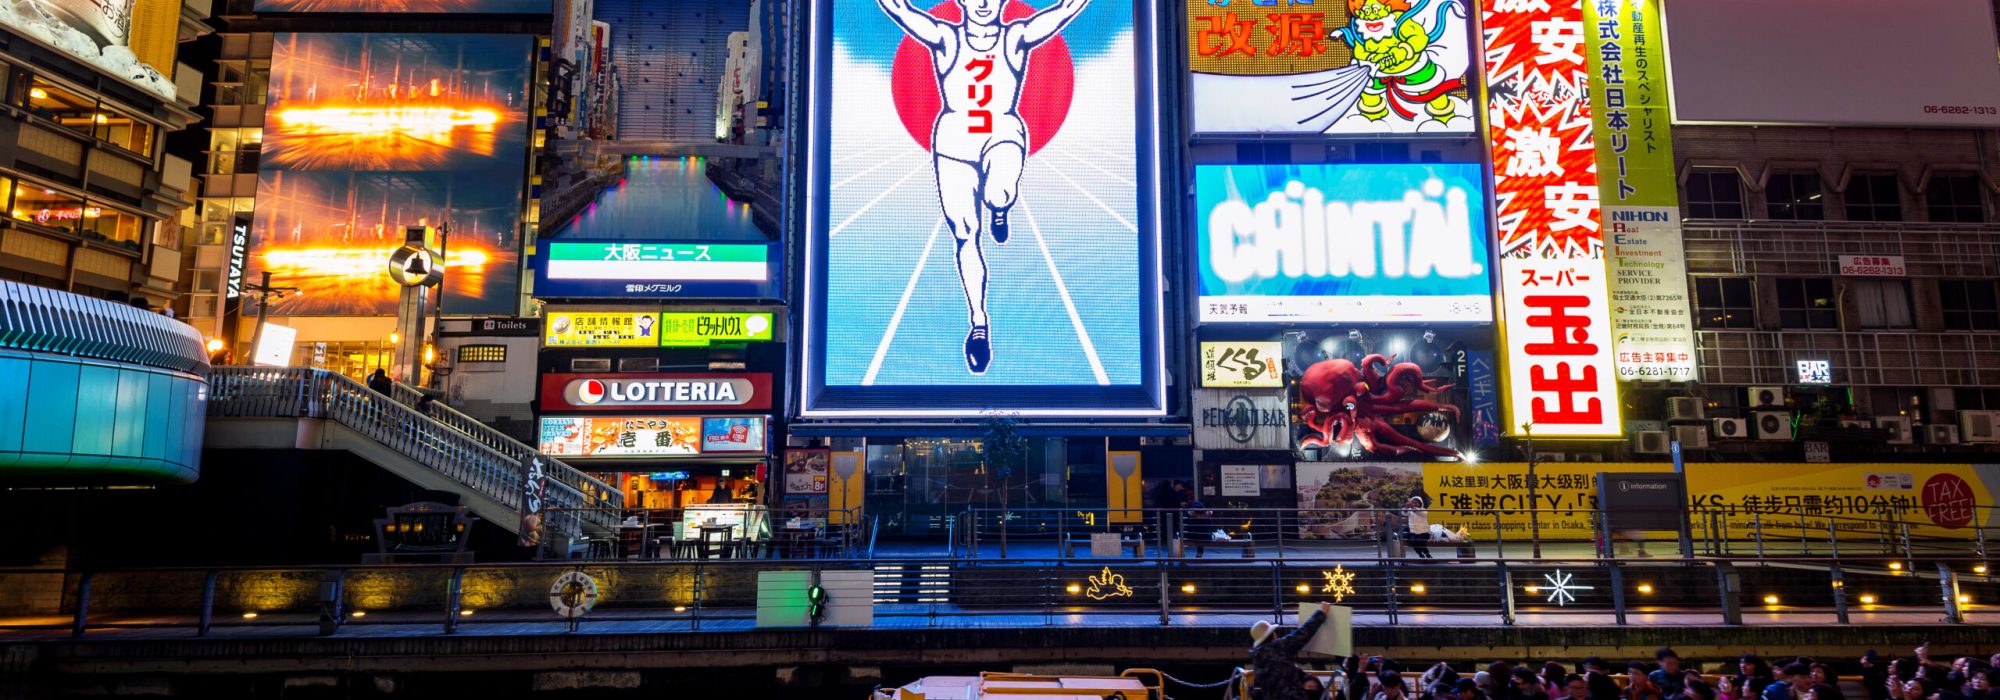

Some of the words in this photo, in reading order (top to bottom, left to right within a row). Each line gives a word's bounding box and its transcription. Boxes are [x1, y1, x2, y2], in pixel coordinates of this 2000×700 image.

[1196, 12, 1328, 57] 改源
[965, 54, 995, 133] グリコ
[1597, 0, 1635, 200] 株式会社日本リート
[1923, 105, 1997, 115] 06-6262-1313
[1504, 127, 1601, 238] 激安
[1612, 211, 1668, 222] NIHON
[1613, 223, 1639, 233] Real
[1614, 235, 1647, 245] Estate
[603, 244, 712, 261] 大阪ニュース
[1615, 246, 1662, 257] Investment
[227, 225, 246, 298] TSUTAYA
[1616, 257, 1664, 269] Technology
[1853, 257, 1890, 265] 広告募集
[1617, 269, 1653, 277] SERVICE
[1842, 266, 1904, 275] 06-6262-1313
[1521, 268, 1589, 286] スーパー
[1618, 277, 1661, 285] PROVIDER
[625, 283, 682, 293] 雪印メグミルク
[1208, 303, 1248, 315] 天気予報
[496, 321, 527, 329] Toilets
[697, 316, 741, 335] ピタットハウス
[1523, 295, 1603, 424] 玉出
[1619, 352, 1688, 363] 広告主募集中
[1216, 347, 1266, 380] くくる
[1798, 361, 1830, 376] BAR
[1620, 366, 1690, 376] 06-6281-1717
[610, 382, 736, 401] LOTTERIA
[1262, 408, 1286, 427] BAR
[625, 419, 668, 429] たこやき
[1805, 443, 1828, 453] BAR
[814, 481, 825, 491] 8F
[1630, 482, 1667, 490] information
[1927, 477, 1965, 503] TAX
[1442, 520, 1470, 531] Largt
[1472, 520, 1491, 530] class
[1493, 520, 1526, 532] sopping
[1528, 520, 1550, 530] cnter
[1552, 520, 1559, 530] in
[1561, 520, 1586, 531] Osaka,
[1829, 521, 1868, 531] orrespond
